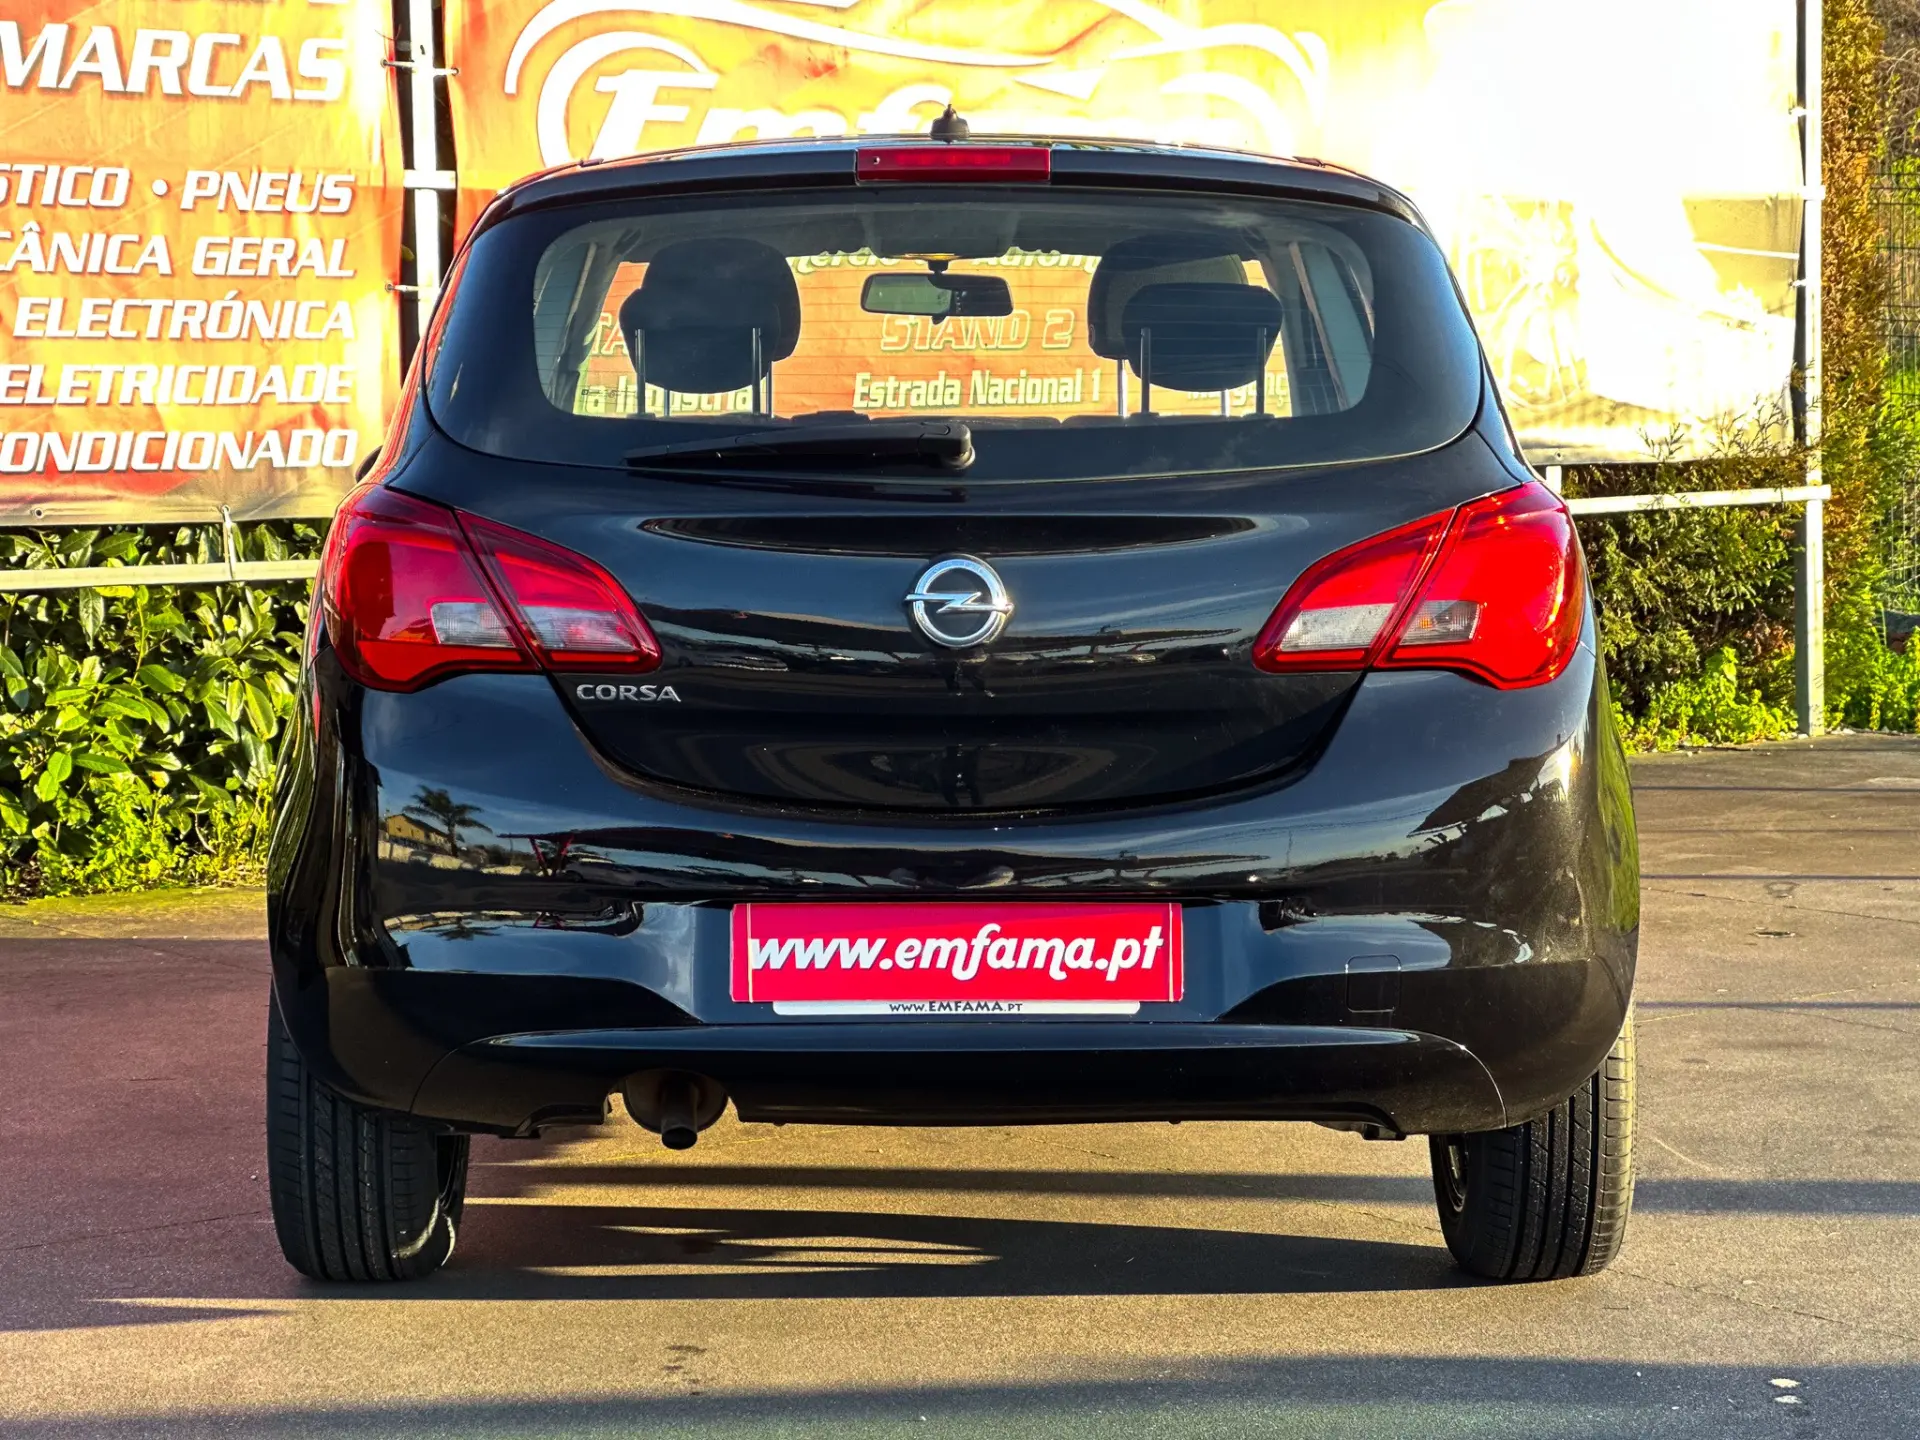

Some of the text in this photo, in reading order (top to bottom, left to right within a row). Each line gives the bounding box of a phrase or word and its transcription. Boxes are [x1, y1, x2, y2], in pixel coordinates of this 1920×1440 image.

[0, 21, 349, 101] MARCAS
[180, 168, 356, 214] PNEUS
[192, 236, 356, 278] GERAL
[13, 290, 354, 340] ELECTRÓNICA
[881, 313, 1032, 351] STAND
[1042, 308, 1076, 350] 2
[0, 364, 355, 406] ELETRICIDADE
[852, 366, 1102, 409] Estrada Nacional 1
[0, 429, 359, 473] ONDICIONADO
[576, 684, 682, 702] CORSA
[750, 923, 1164, 982] www.emfama.pt
